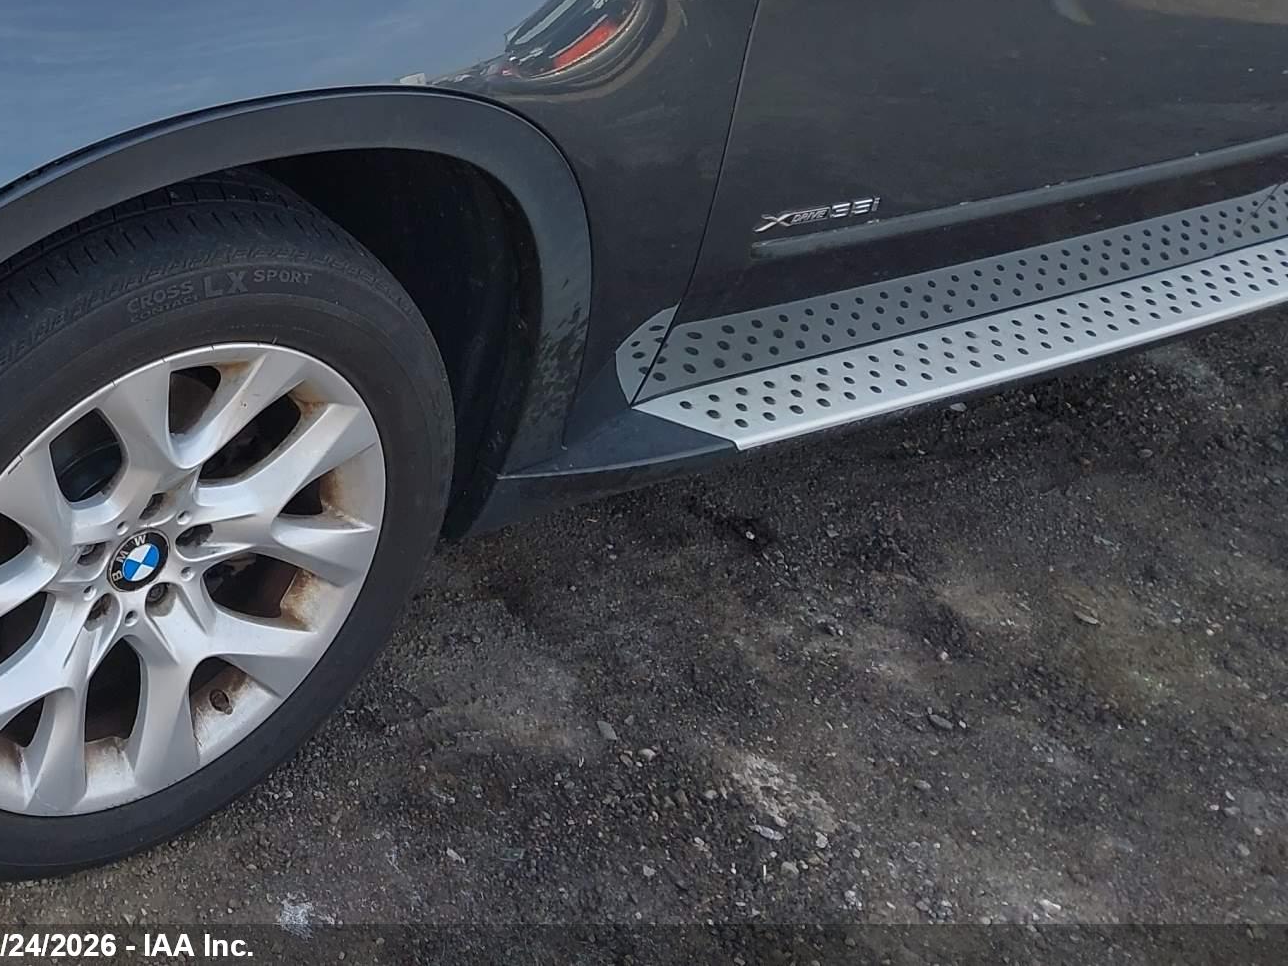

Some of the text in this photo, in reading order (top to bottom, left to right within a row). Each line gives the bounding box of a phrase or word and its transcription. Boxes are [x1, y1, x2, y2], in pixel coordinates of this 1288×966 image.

[127, 269, 313, 313] CROSS LX SPORT
[112, 535, 146, 580] BMW
